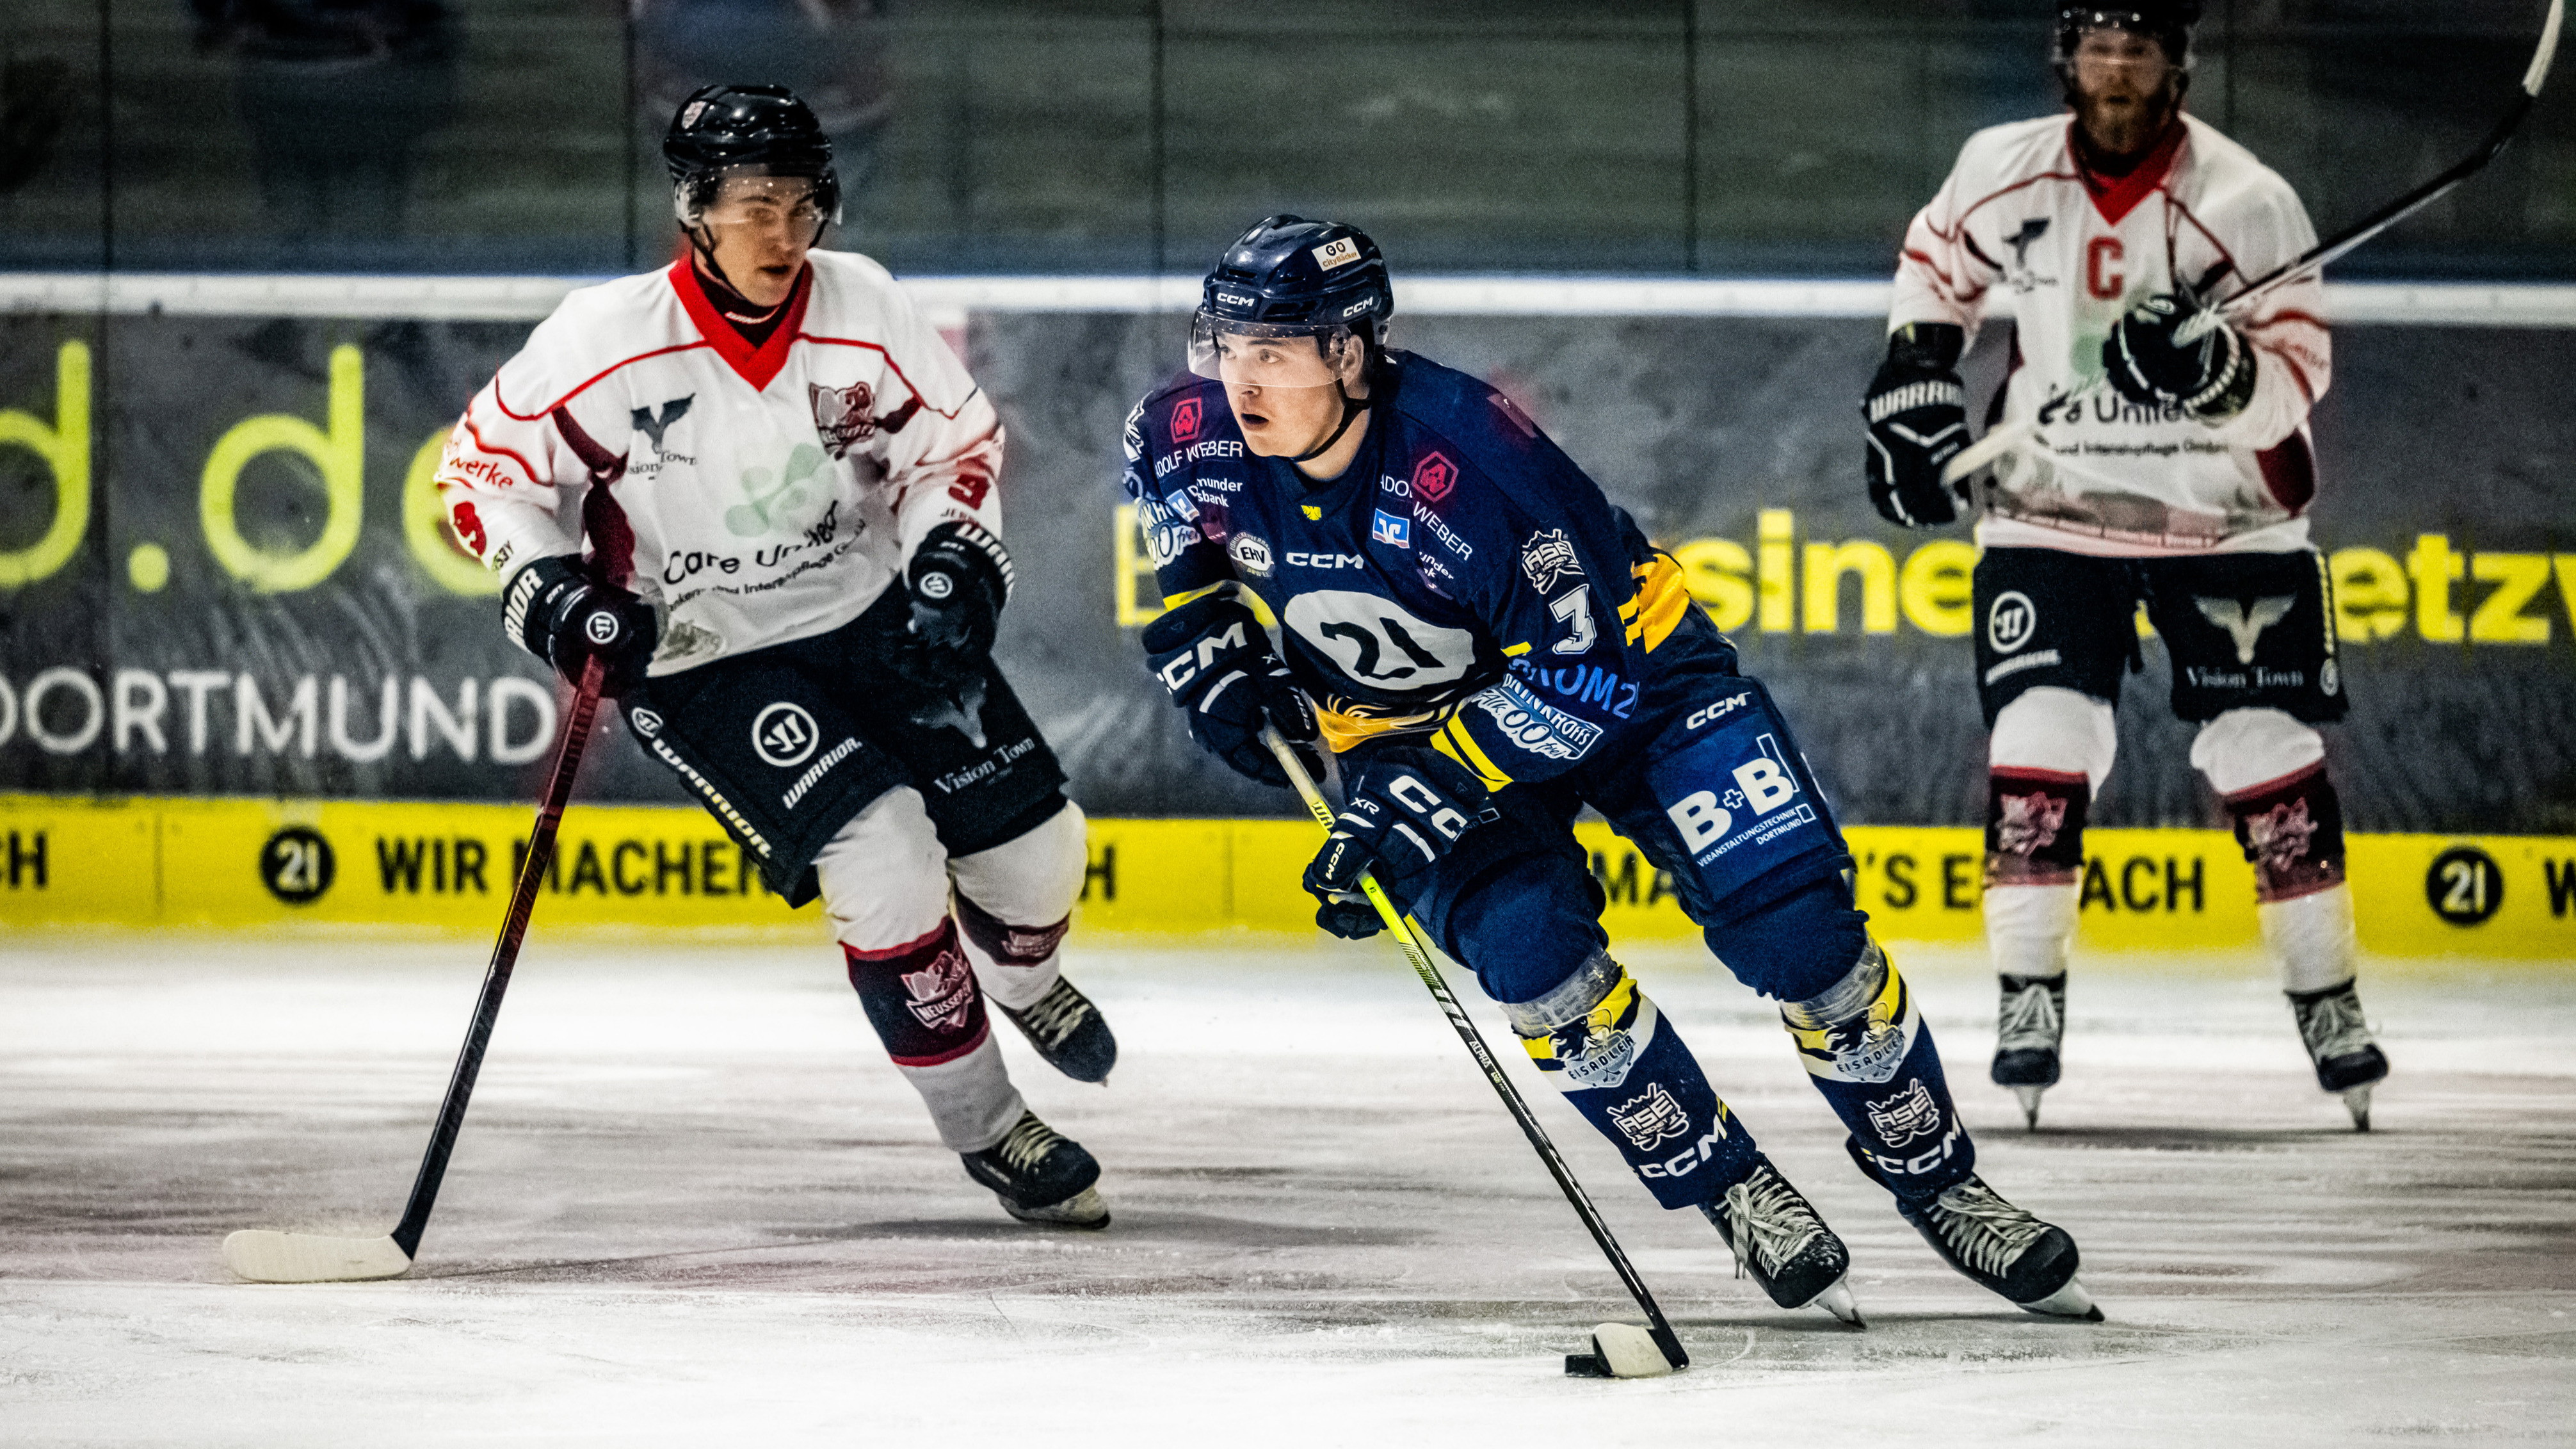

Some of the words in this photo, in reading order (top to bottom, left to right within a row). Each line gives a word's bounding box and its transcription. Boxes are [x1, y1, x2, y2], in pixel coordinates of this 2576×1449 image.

[2088, 237, 2123, 300] C
[1216, 293, 1255, 307] CCM
[1343, 296, 1373, 318] CCM
[1186, 440, 1244, 462] WEBER
[1413, 501, 1473, 562] WEBER
[664, 549, 741, 585] Care
[1241, 546, 1266, 564] EHV
[1286, 553, 1364, 569] CCM
[1525, 542, 1573, 571] ASE
[1156, 621, 1248, 695] CM
[1321, 617, 1446, 680] 21
[0, 666, 557, 765] ORTMUND
[1686, 692, 1751, 730] CCM
[933, 760, 997, 794] Vision
[993, 737, 1036, 764] Town
[1389, 775, 1468, 841] CC
[1667, 757, 1794, 855] B+B
[1697, 808, 1797, 867] VERANSTALTUNGSTECHNIK
[1755, 818, 1803, 845] DORTMUND
[275, 840, 321, 892] 21
[376, 837, 488, 894] WIR
[1325, 842, 1345, 880] CCM
[2440, 858, 2486, 913] 21
[1618, 1095, 1674, 1133] ASE
[1875, 1091, 1929, 1128] ASE
[1638, 1113, 1727, 1178] CCM
